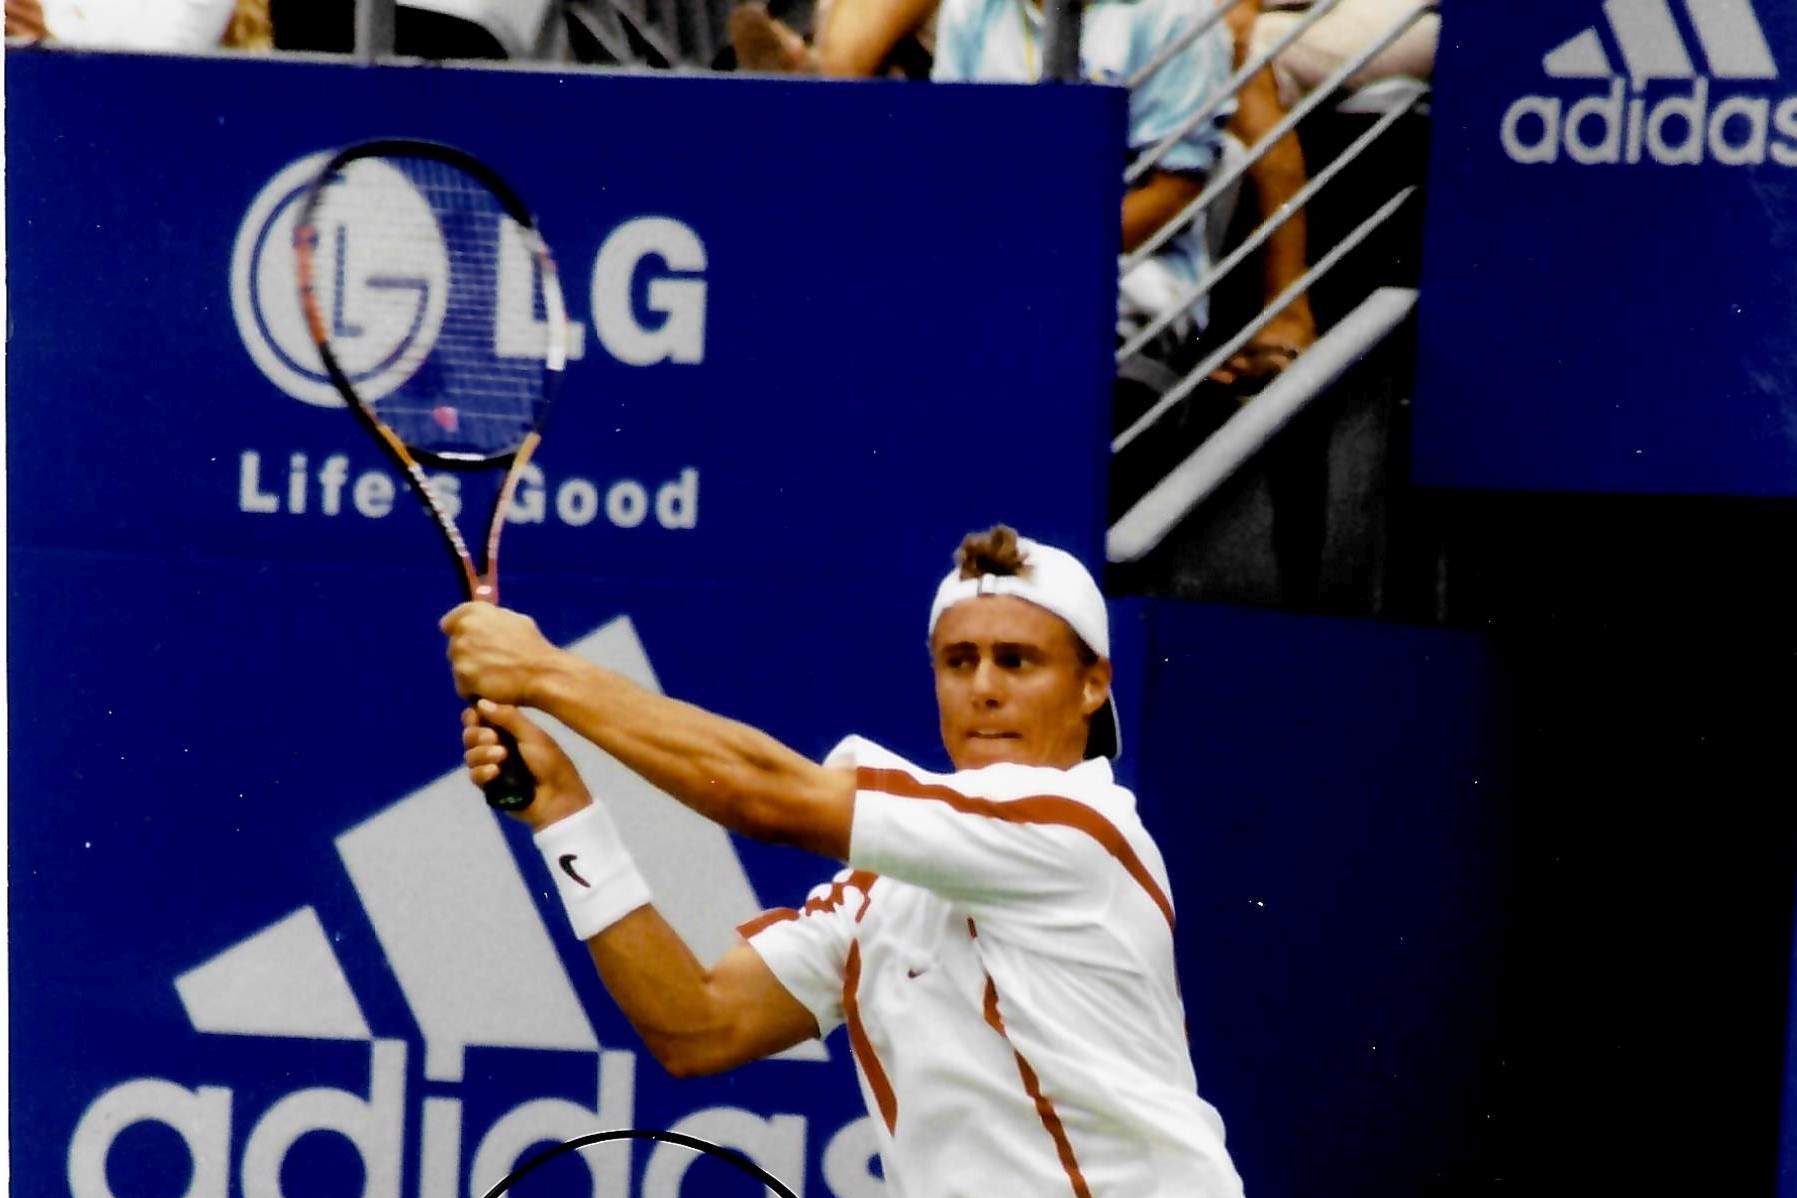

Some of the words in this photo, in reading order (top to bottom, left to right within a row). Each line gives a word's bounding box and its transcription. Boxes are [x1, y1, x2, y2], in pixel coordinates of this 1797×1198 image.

[494, 212, 709, 367] LG
[239, 450, 462, 522] Lifes
[503, 463, 700, 530] Good
